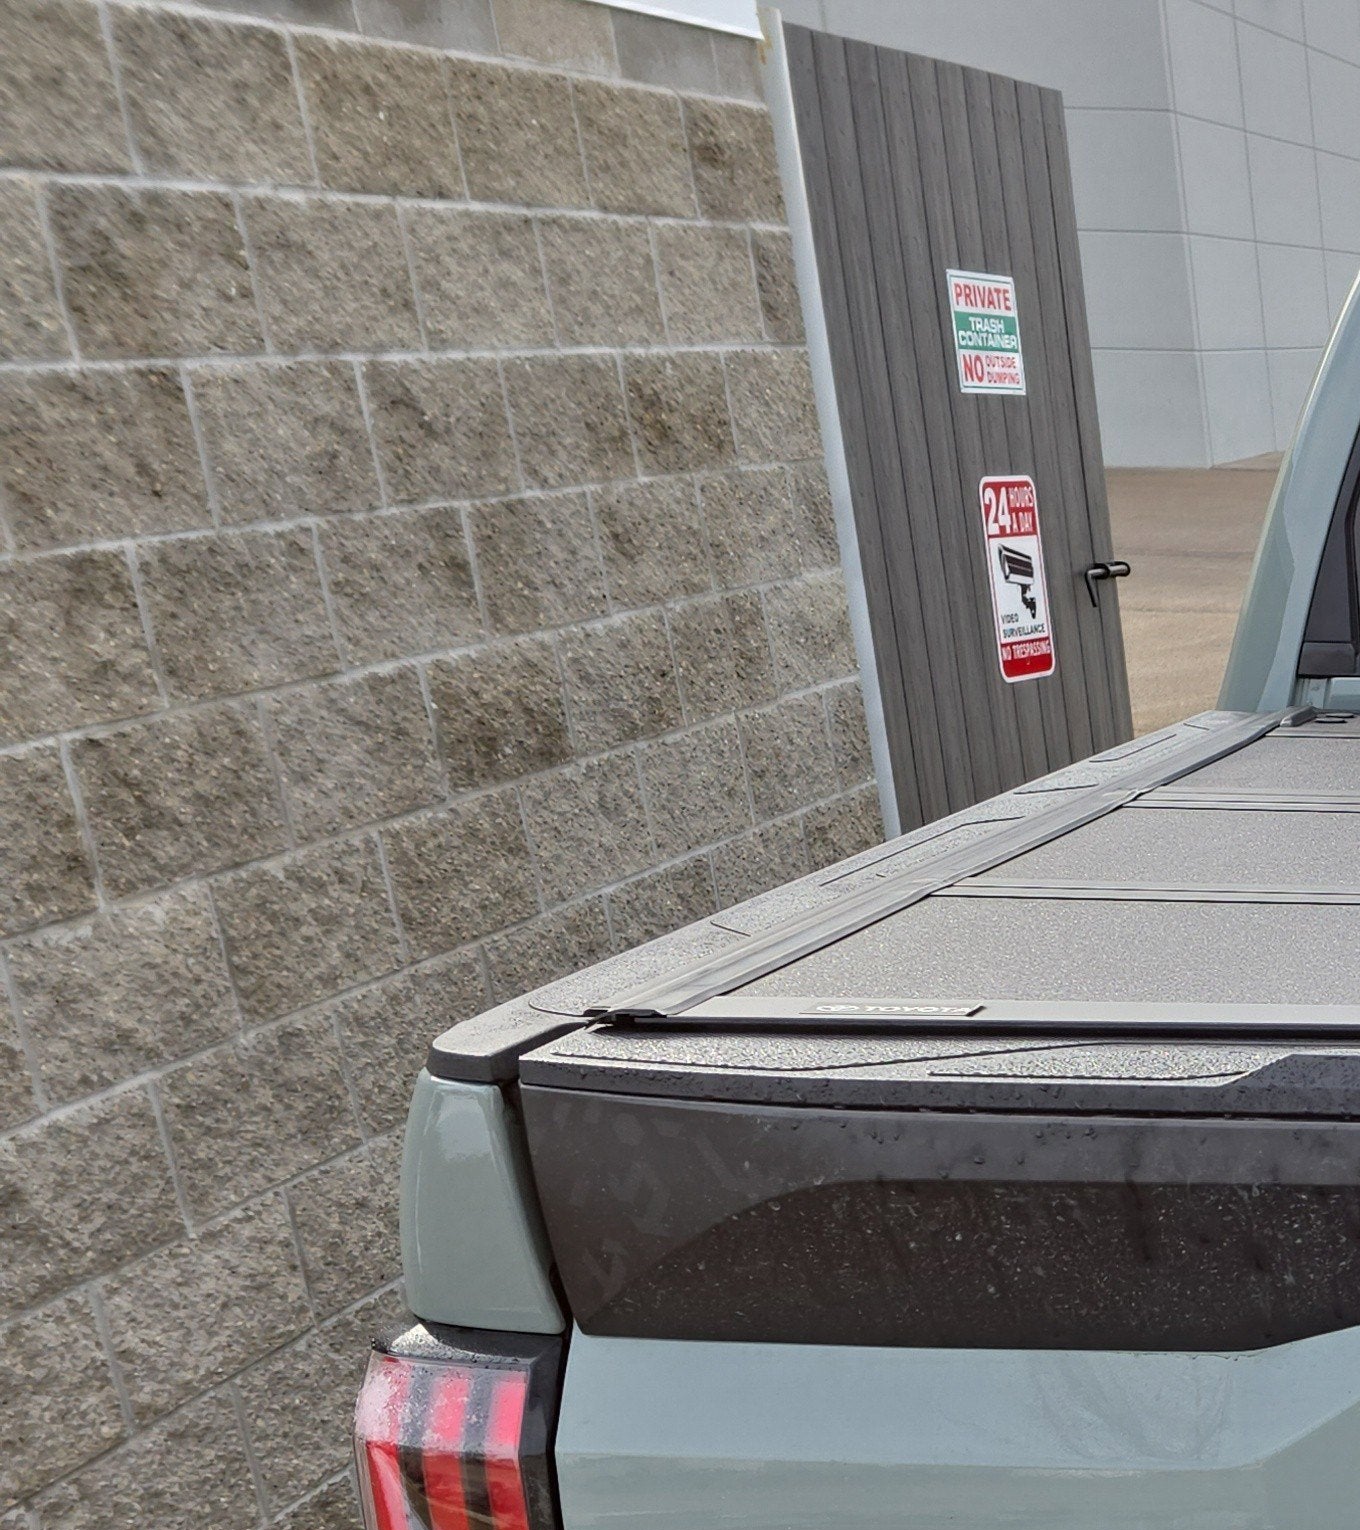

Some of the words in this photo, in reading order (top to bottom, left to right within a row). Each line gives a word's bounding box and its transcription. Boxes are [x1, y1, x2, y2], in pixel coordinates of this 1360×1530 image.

[954, 282, 1011, 311] PRIVATE
[968, 316, 1005, 334] TRASH
[958, 330, 1018, 349] CONTAINER
[962, 354, 985, 383] NO
[985, 355, 1017, 369] OUTSIDE
[987, 371, 1021, 385] DUMPING
[984, 486, 1011, 535] 24
[1018, 511, 1034, 533] DAY
[1001, 612, 1019, 624] VIDEO
[1002, 623, 1046, 638] SURVEILLANCE
[865, 1005, 974, 1014] TOYOTA
